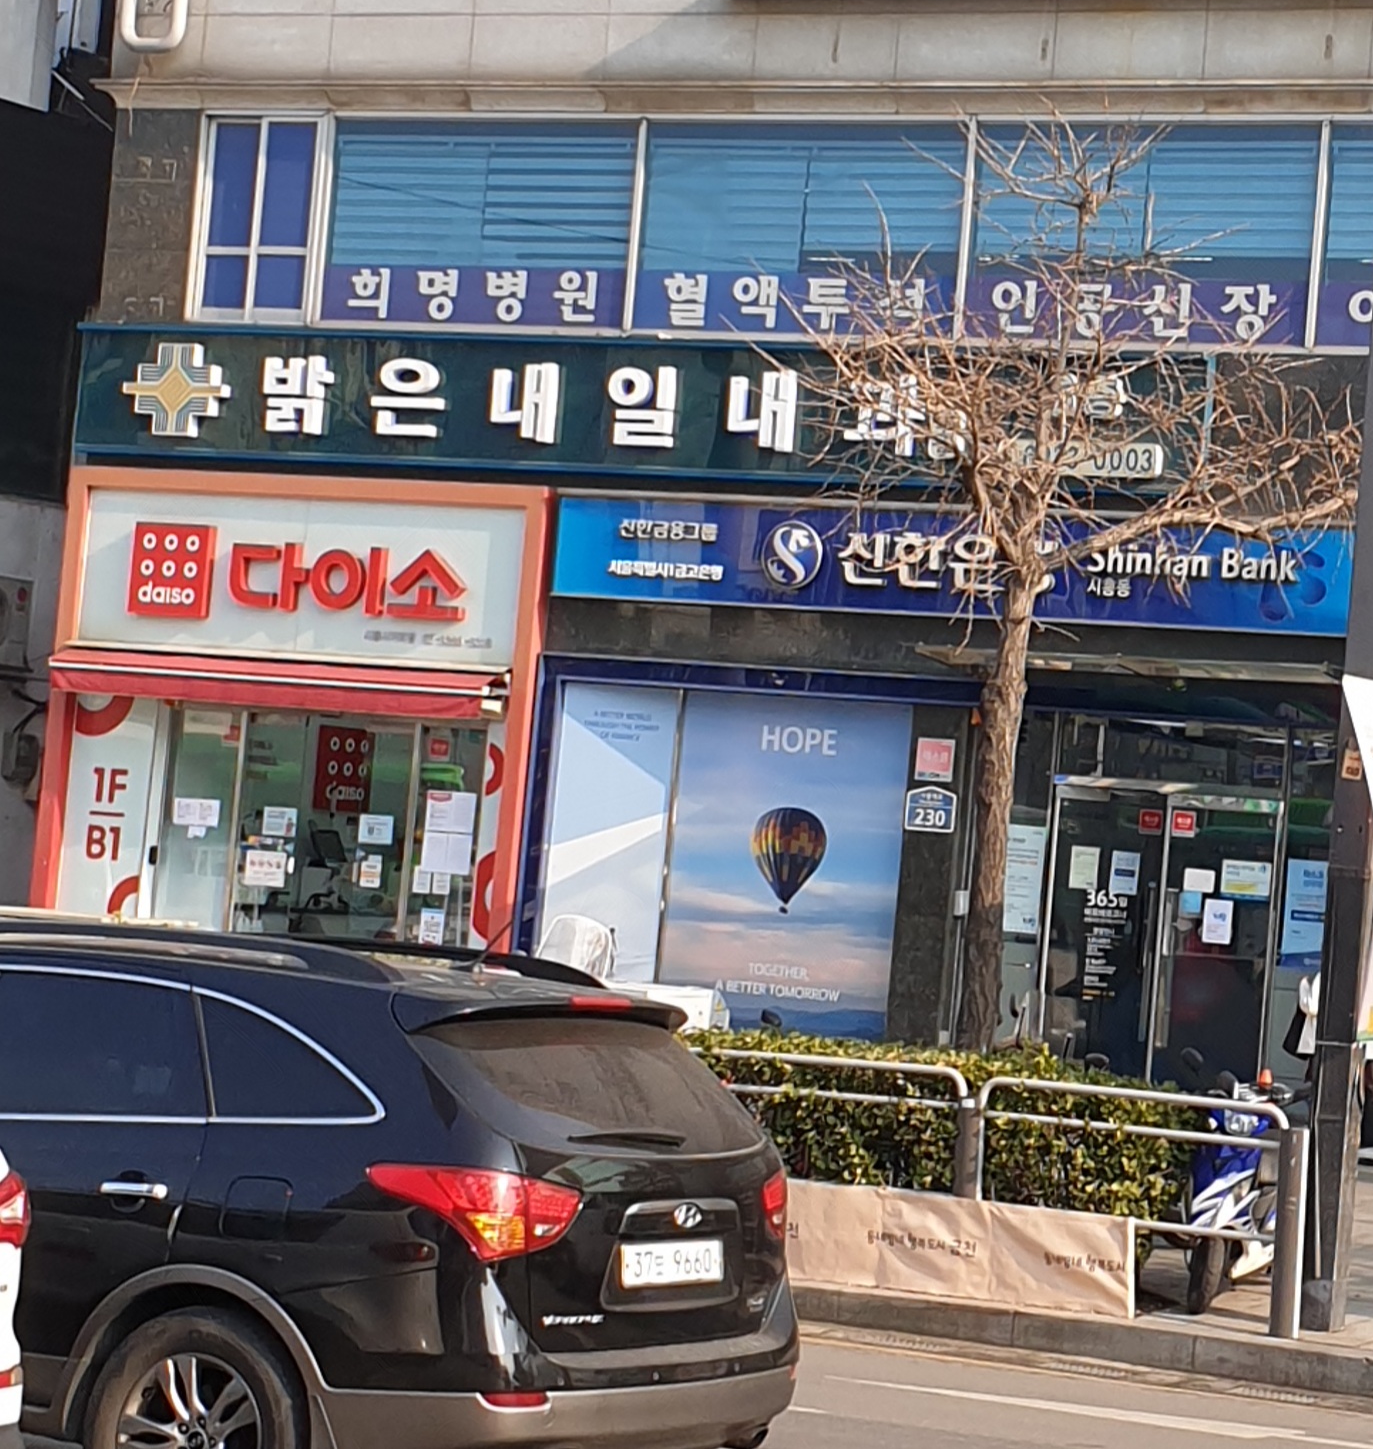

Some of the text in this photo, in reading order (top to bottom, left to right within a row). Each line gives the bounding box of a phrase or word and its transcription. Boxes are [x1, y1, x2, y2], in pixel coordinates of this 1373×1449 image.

[347, 267, 598, 323] 희명병원
[618, 518, 719, 543] 신한금융그룹
[837, 531, 1059, 593] 신한은
[1086, 545, 1298, 583] Shinhan Bank
[137, 579, 196, 606] daiso
[228, 541, 467, 622] 다이소
[1086, 579, 1133, 600] 시흥동
[761, 724, 838, 757] HOPE
[93, 766, 129, 804] 1F
[913, 808, 946, 827] 230
[85, 824, 122, 861] B1
[715, 979, 841, 1003] A BETTER TOMORROW
[673, 1247, 713, 1276] 9660
